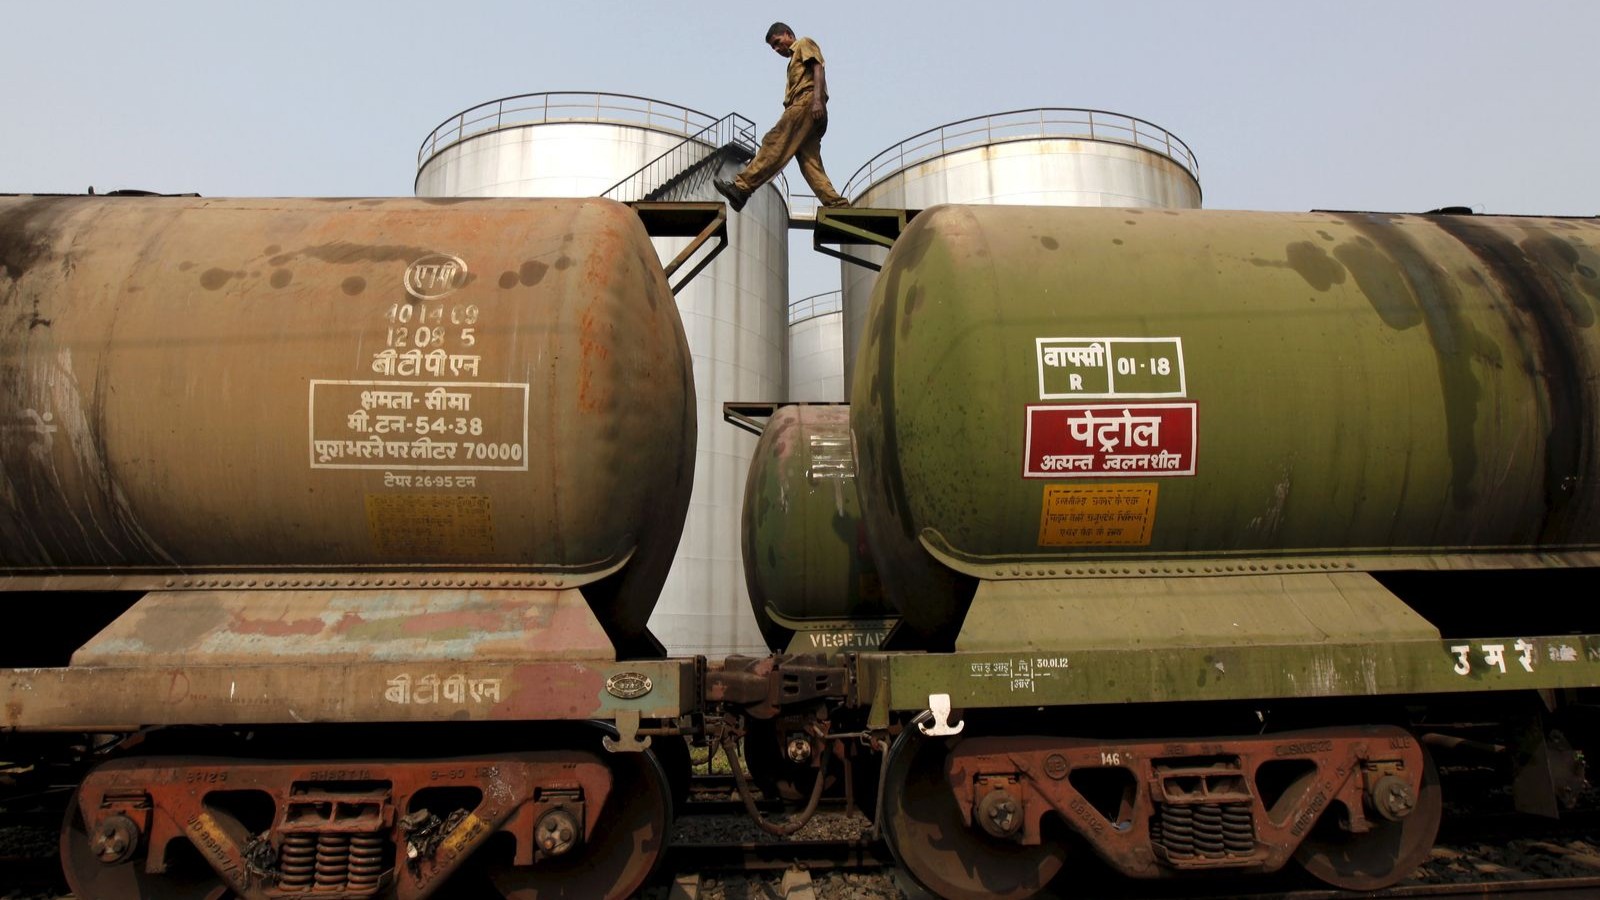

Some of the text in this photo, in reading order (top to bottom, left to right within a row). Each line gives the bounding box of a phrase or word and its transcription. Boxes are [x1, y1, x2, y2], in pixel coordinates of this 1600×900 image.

[1069, 373, 1083, 390] R
[425, 387, 472, 411] सीमा
[1067, 408, 1162, 452] पेट्रोल
[314, 435, 522, 463] पूरा भरने पर लीटर 70000
[455, 476, 476, 488] टन
[1100, 751, 1120, 766] 146
